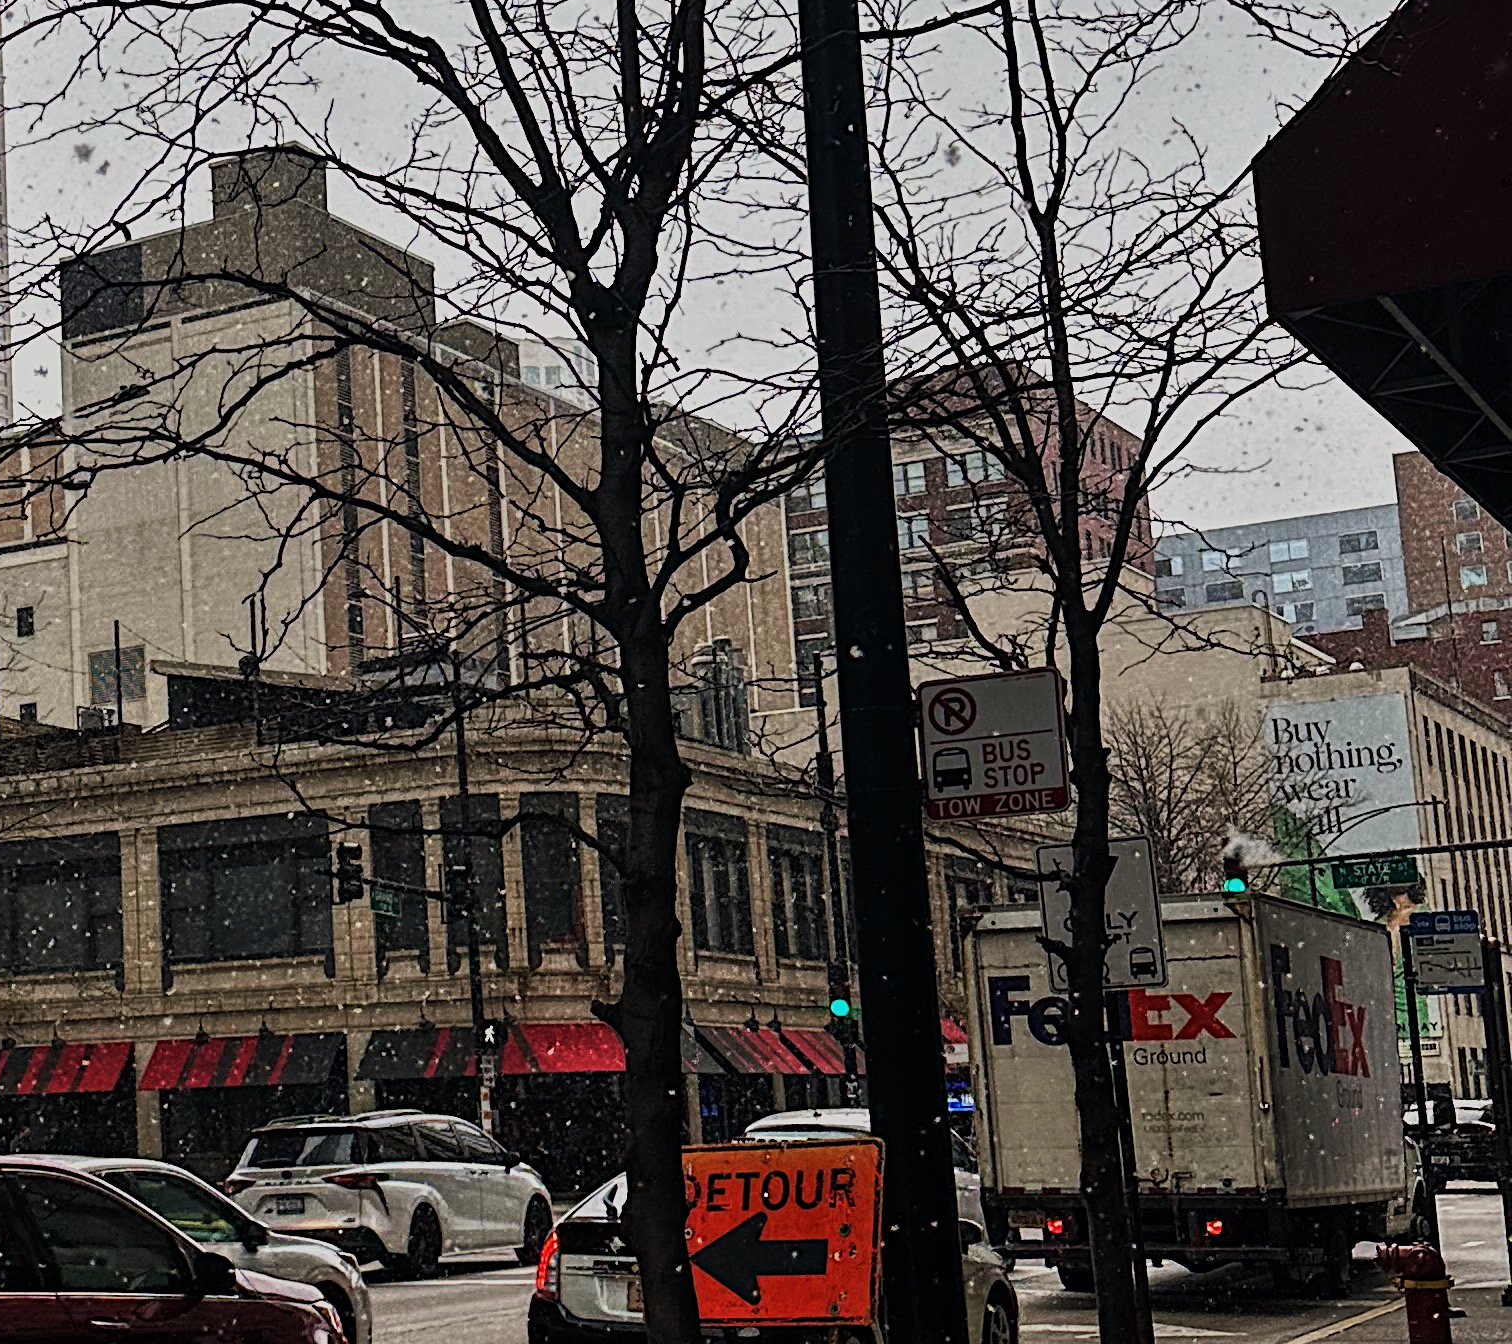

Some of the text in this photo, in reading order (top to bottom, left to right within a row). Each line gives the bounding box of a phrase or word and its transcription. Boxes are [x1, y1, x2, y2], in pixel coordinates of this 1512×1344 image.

[1272, 718, 1332, 747] Buy
[982, 739, 1031, 764] BUS
[1275, 741, 1403, 774] nothing,
[984, 762, 1045, 788] STOP
[935, 790, 1055, 817] TOW ZONE
[1271, 778, 1356, 804] wear
[1353, 862, 1391, 876] STATE
[988, 975, 1237, 1046] FeEx
[1271, 944, 1370, 1077] FedEx
[1133, 1047, 1207, 1066] Ground
